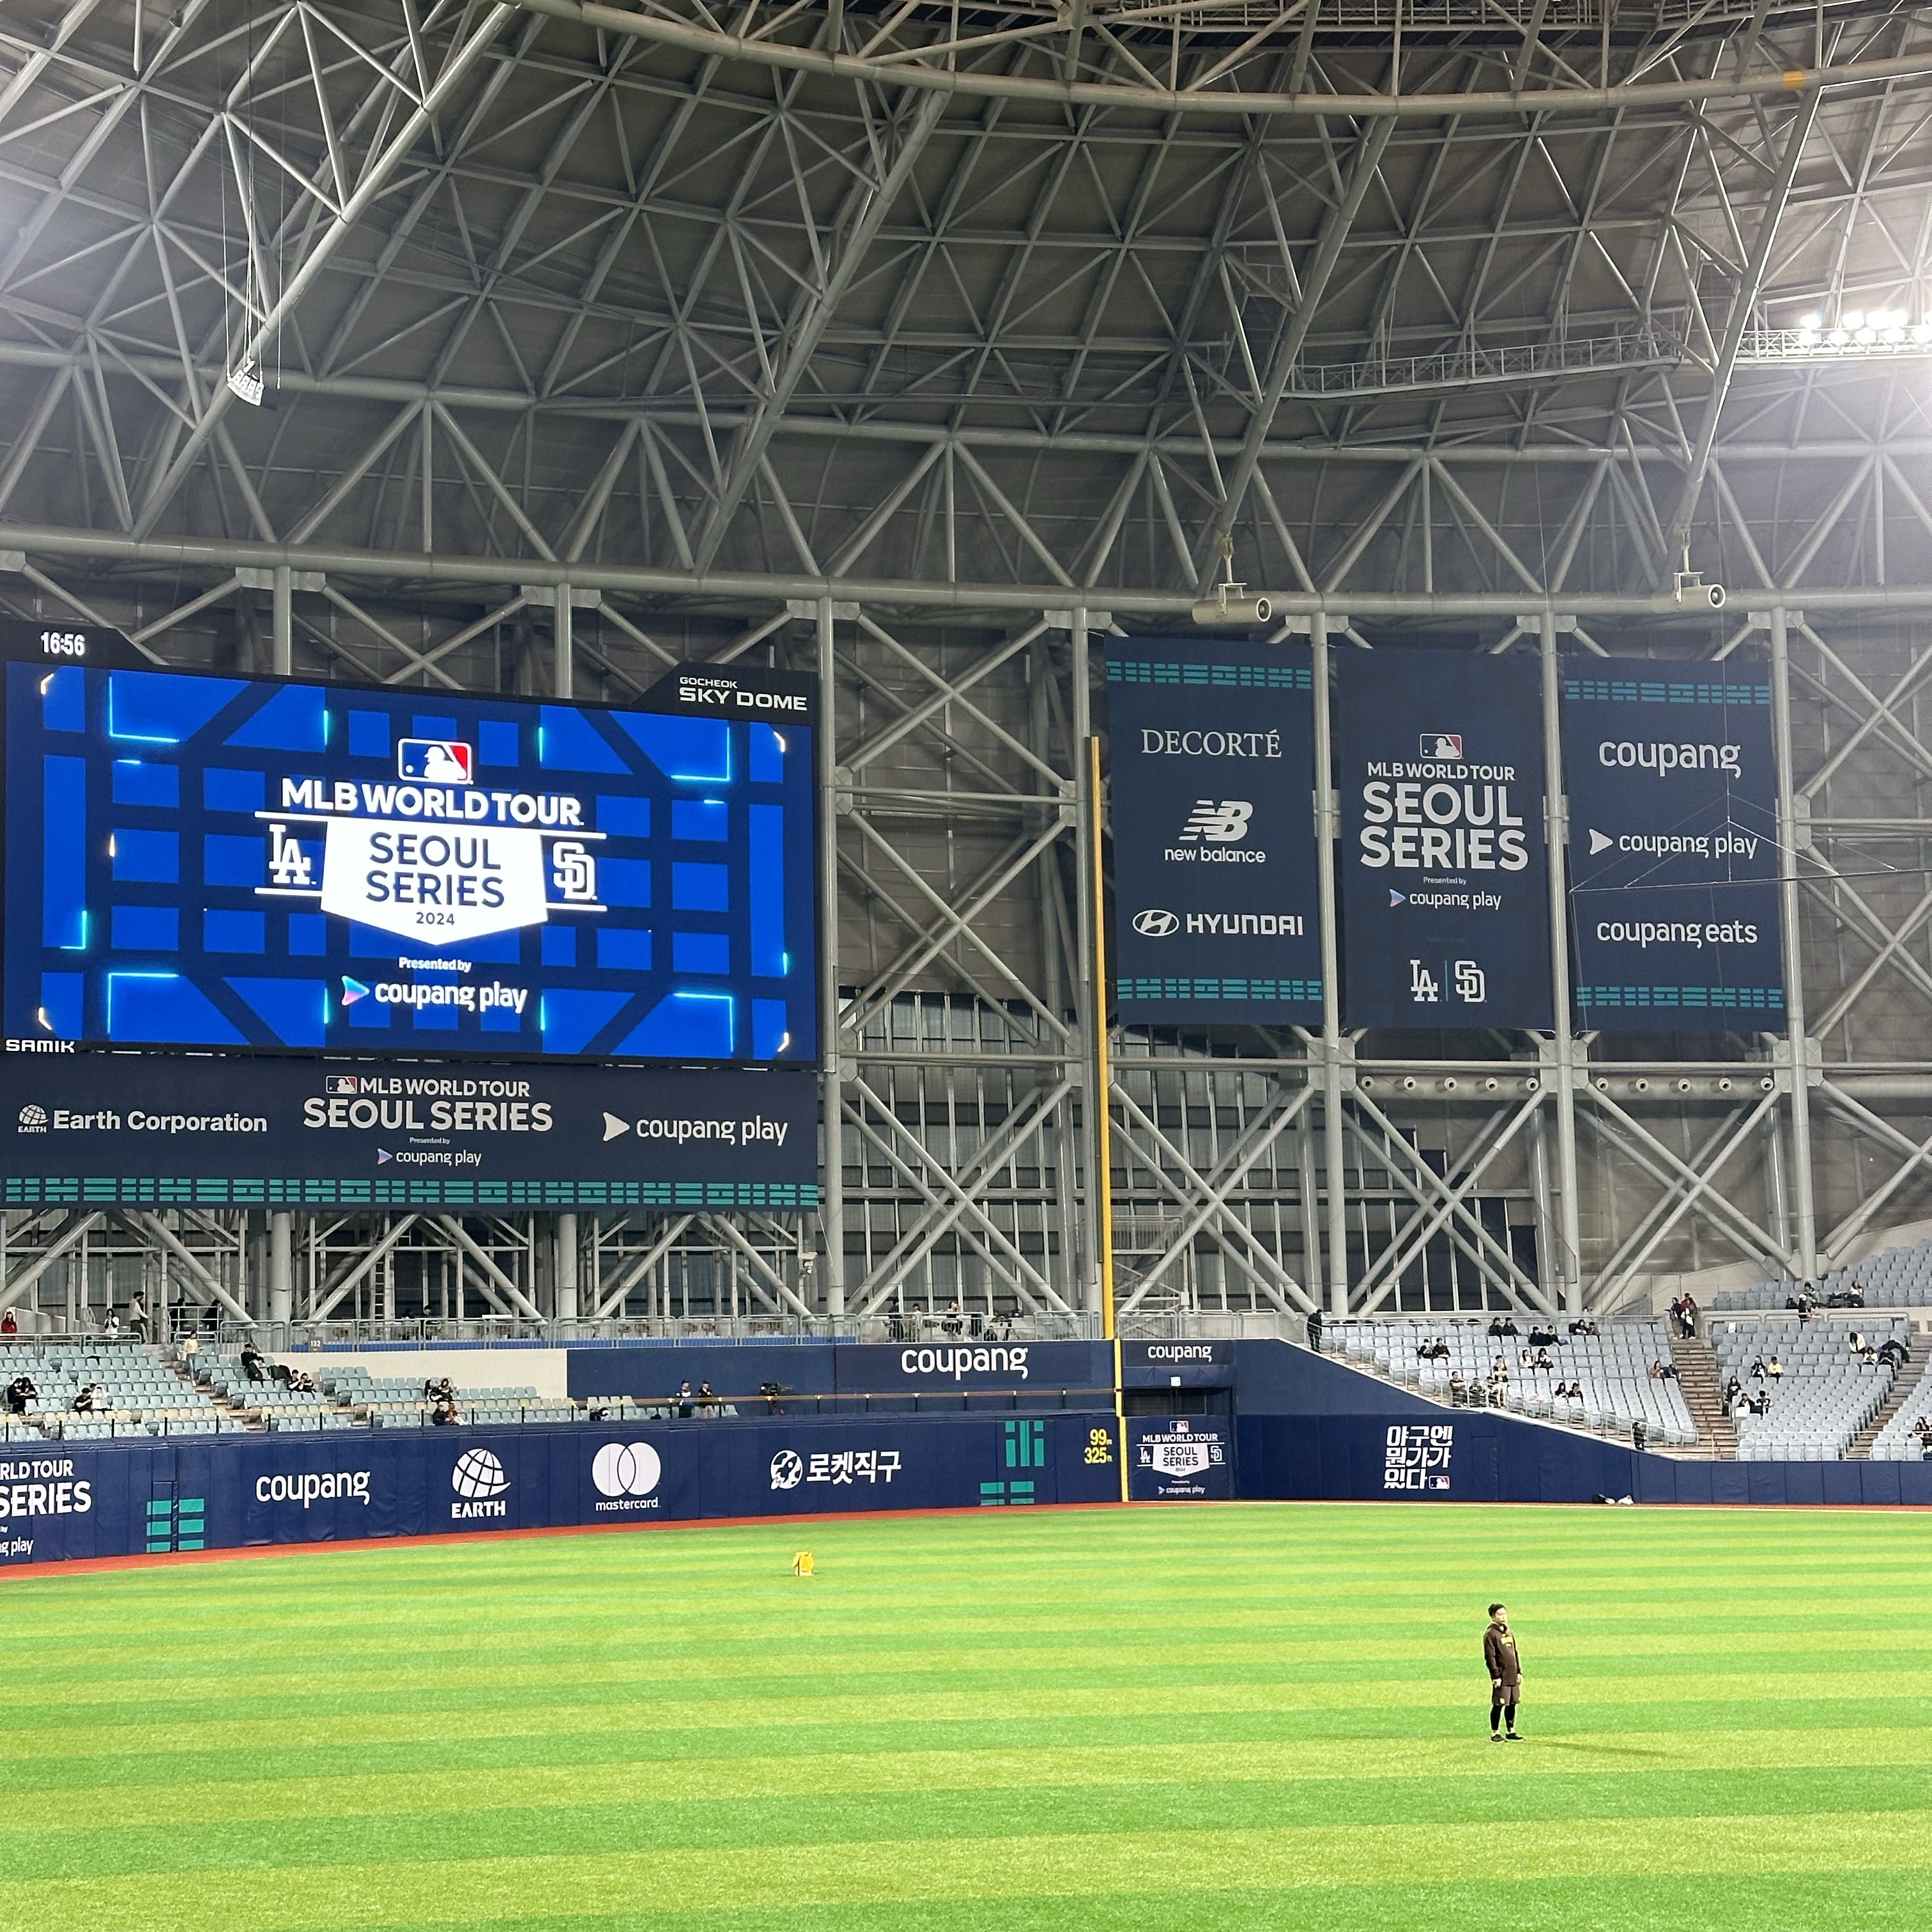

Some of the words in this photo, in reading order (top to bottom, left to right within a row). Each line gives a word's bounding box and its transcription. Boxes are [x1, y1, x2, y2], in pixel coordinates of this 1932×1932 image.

[41, 631, 85, 656] 16:56
[679, 677, 738, 689] GOCHEOK
[679, 687, 731, 704] SKY
[737, 691, 808, 711] DOME
[1141, 728, 1282, 758] DECORTÉ
[1598, 741, 1742, 779] coupang
[1367, 762, 1404, 777] MLB
[1406, 763, 1468, 779] WORLD
[1469, 765, 1515, 781] TOUR
[282, 778, 358, 811] MLB
[361, 783, 489, 820] WORLD
[491, 792, 582, 825] TOUR
[1363, 781, 1523, 826] SEOUL
[268, 824, 311, 885] LA
[369, 831, 501, 870] SEOUL
[1165, 848, 1197, 861] new
[1200, 847, 1266, 862] balance
[1360, 825, 1529, 871] SERIES
[1619, 834, 1709, 859] coupang
[1715, 831, 1758, 859] play
[553, 841, 596, 900] SD
[1423, 876, 1458, 884] Presented
[365, 870, 504, 908] SERIES
[1409, 893, 1469, 910] coupang
[1473, 891, 1501, 910] play
[416, 912, 455, 926] 2024
[1186, 913, 1303, 935] HYUNDAI
[399, 956, 456, 970] Presented
[457, 960, 471, 972] by
[1410, 960, 1438, 1001] LA
[1455, 960, 1485, 1002] SD
[375, 983, 475, 1012] coupang
[479, 981, 528, 1014] play
[5, 1039, 75, 1054] SAMIK
[360, 1077, 402, 1094] MLB
[404, 1078, 477, 1096] WORLD
[478, 1080, 530, 1098] TOUR
[53, 1110, 121, 1130] Earth
[127, 1110, 268, 1134] Corporation
[303, 1098, 424, 1130] SEOUL
[431, 1100, 553, 1131] SERIES
[636, 1119, 736, 1146] coupang
[741, 1115, 788, 1146] play
[396, 1151, 452, 1167] coupang
[455, 1149, 482, 1167] play
[901, 1347, 1028, 1380] coupang
[1147, 1346, 1212, 1362] coupang
[1142, 1434, 1161, 1443] MLB
[1162, 1433, 1193, 1443] WORLD
[1194, 1433, 1218, 1442] TOUR
[1386, 1425, 1453, 1446] 야구엔
[1163, 1446, 1198, 1456] SEOUL
[1385, 1447, 1452, 1468] 뭔가가
[32, 1459, 74, 1478] TOUR
[806, 1450, 901, 1485] 로켓직구
[1163, 1457, 1199, 1467] SERIES
[1383, 1468, 1428, 1489] 있다
[256, 1471, 371, 1509] coupang
[451, 1500, 506, 1519] EARTH
[595, 1496, 659, 1512] mastercard
[11, 1536, 34, 1556] play
